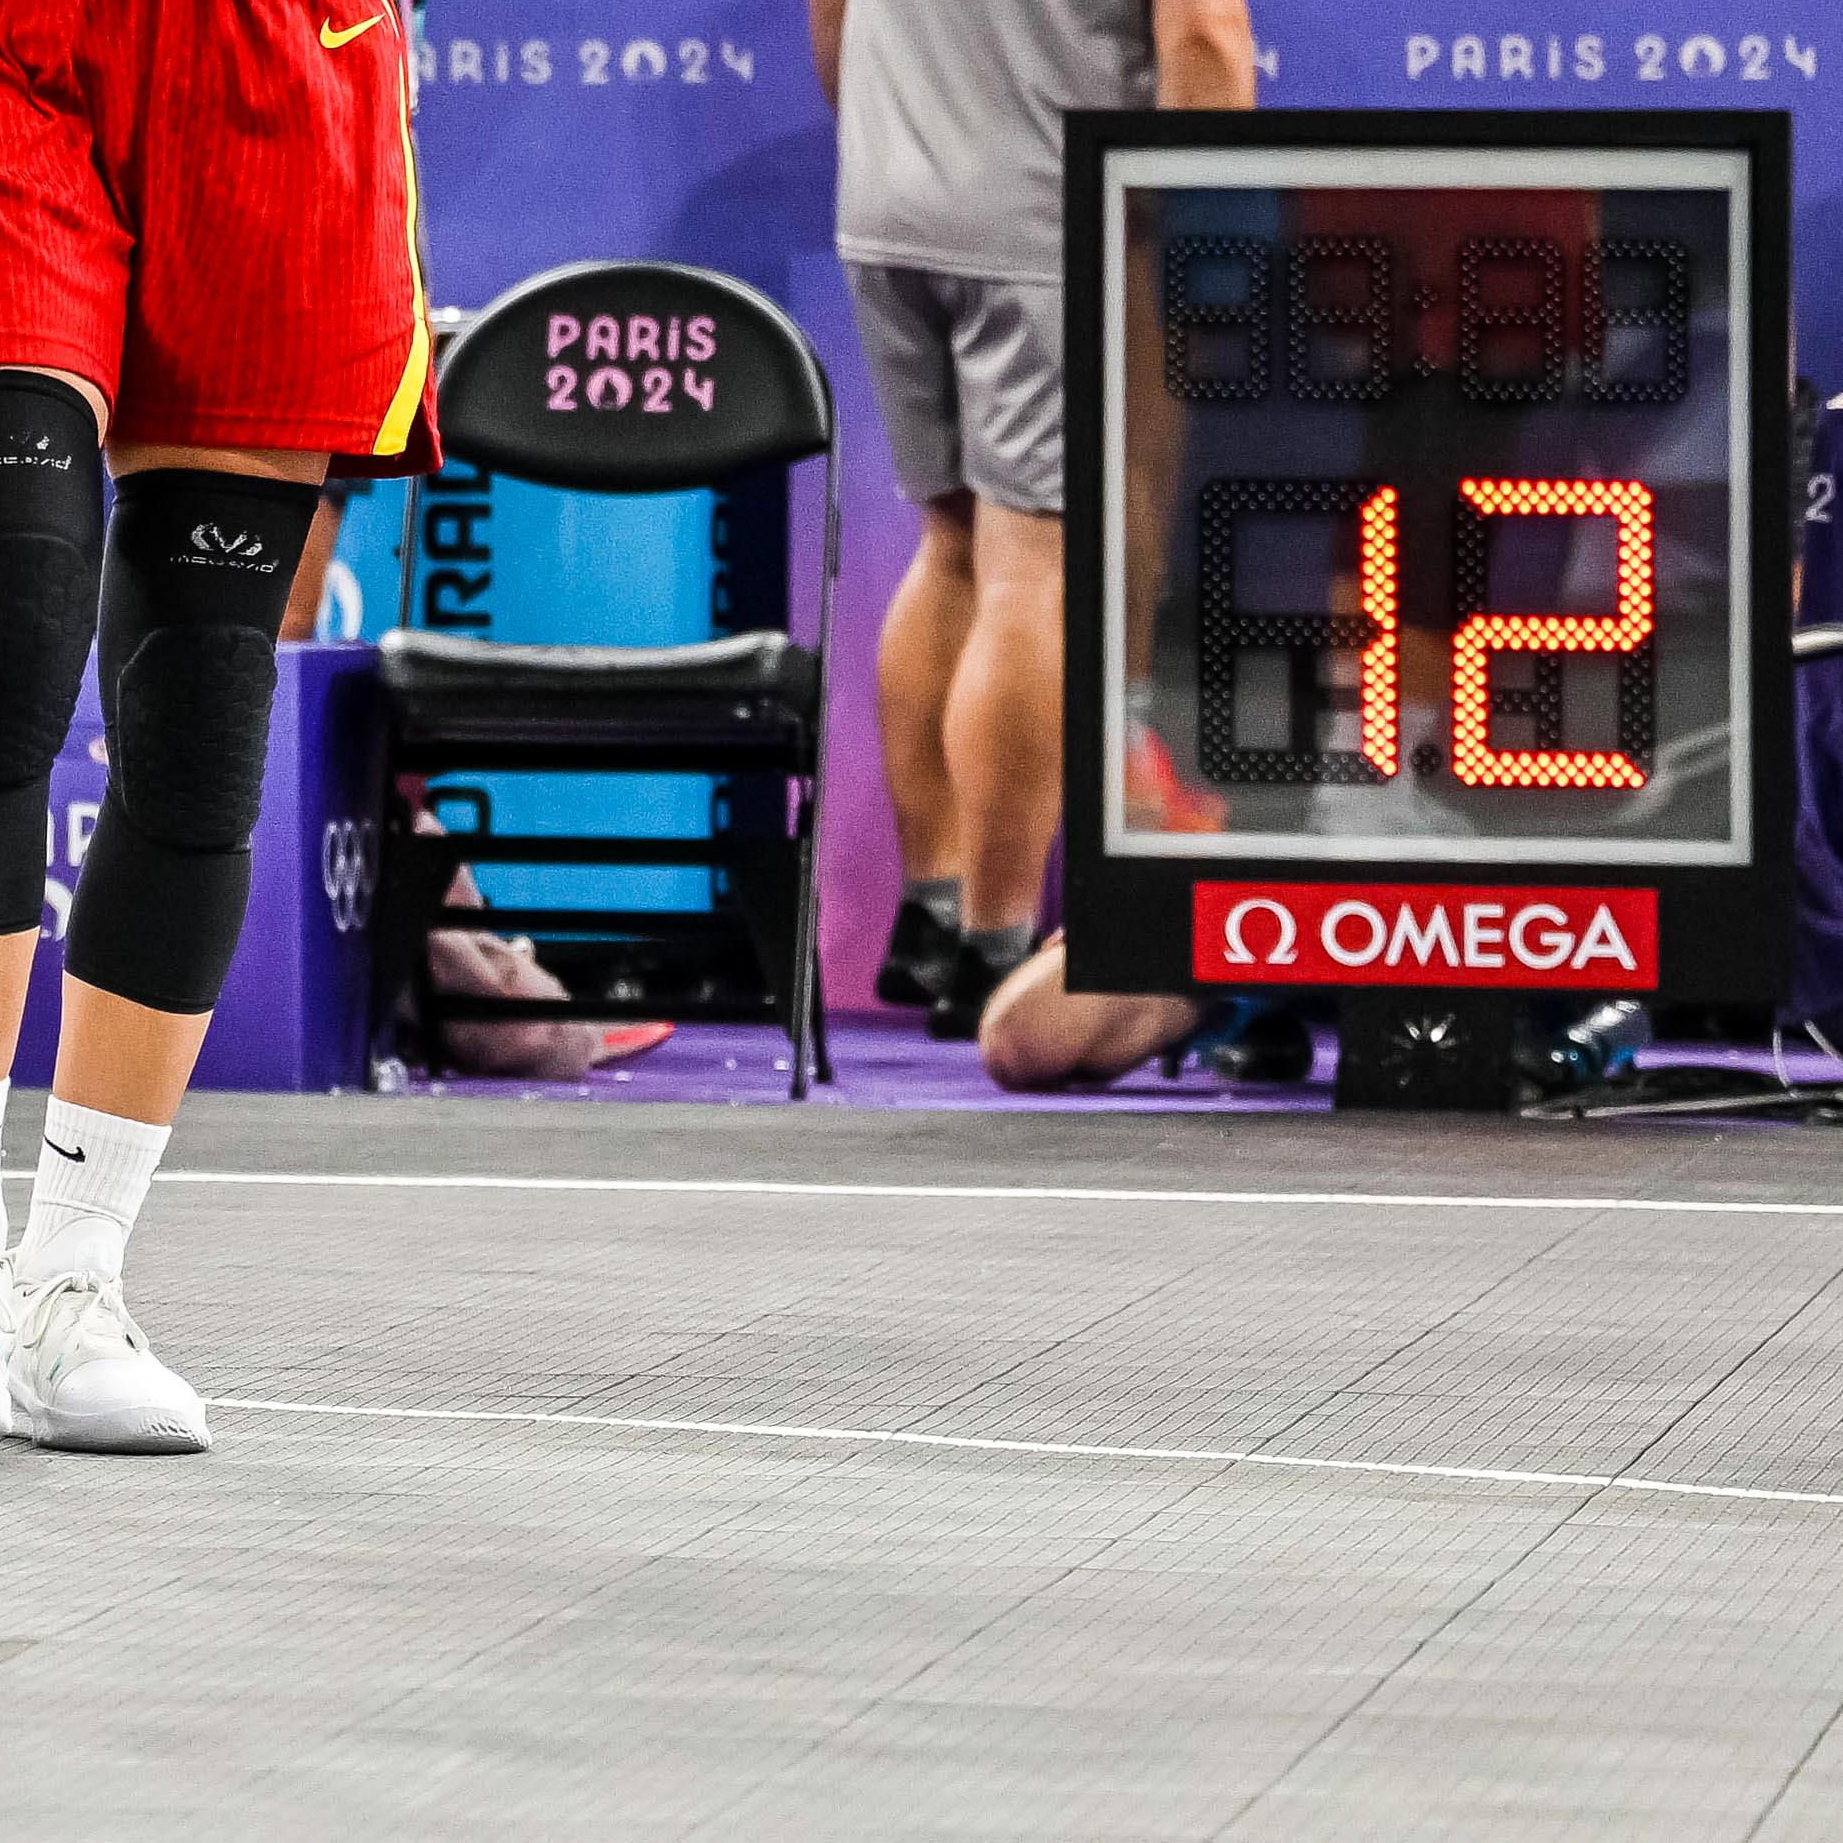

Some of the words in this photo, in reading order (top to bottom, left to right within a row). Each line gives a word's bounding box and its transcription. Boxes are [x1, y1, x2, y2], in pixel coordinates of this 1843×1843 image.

[416, 39, 553, 85] ARIS
[579, 38, 755, 85] 2024
[1407, 35, 1605, 80] PARIS
[1633, 34, 1816, 81] 2024
[546, 315, 717, 362] PARIS
[546, 368, 715, 412] 2024
[1360, 477, 1654, 788] 12
[1319, 900, 1637, 970] OMEGA
